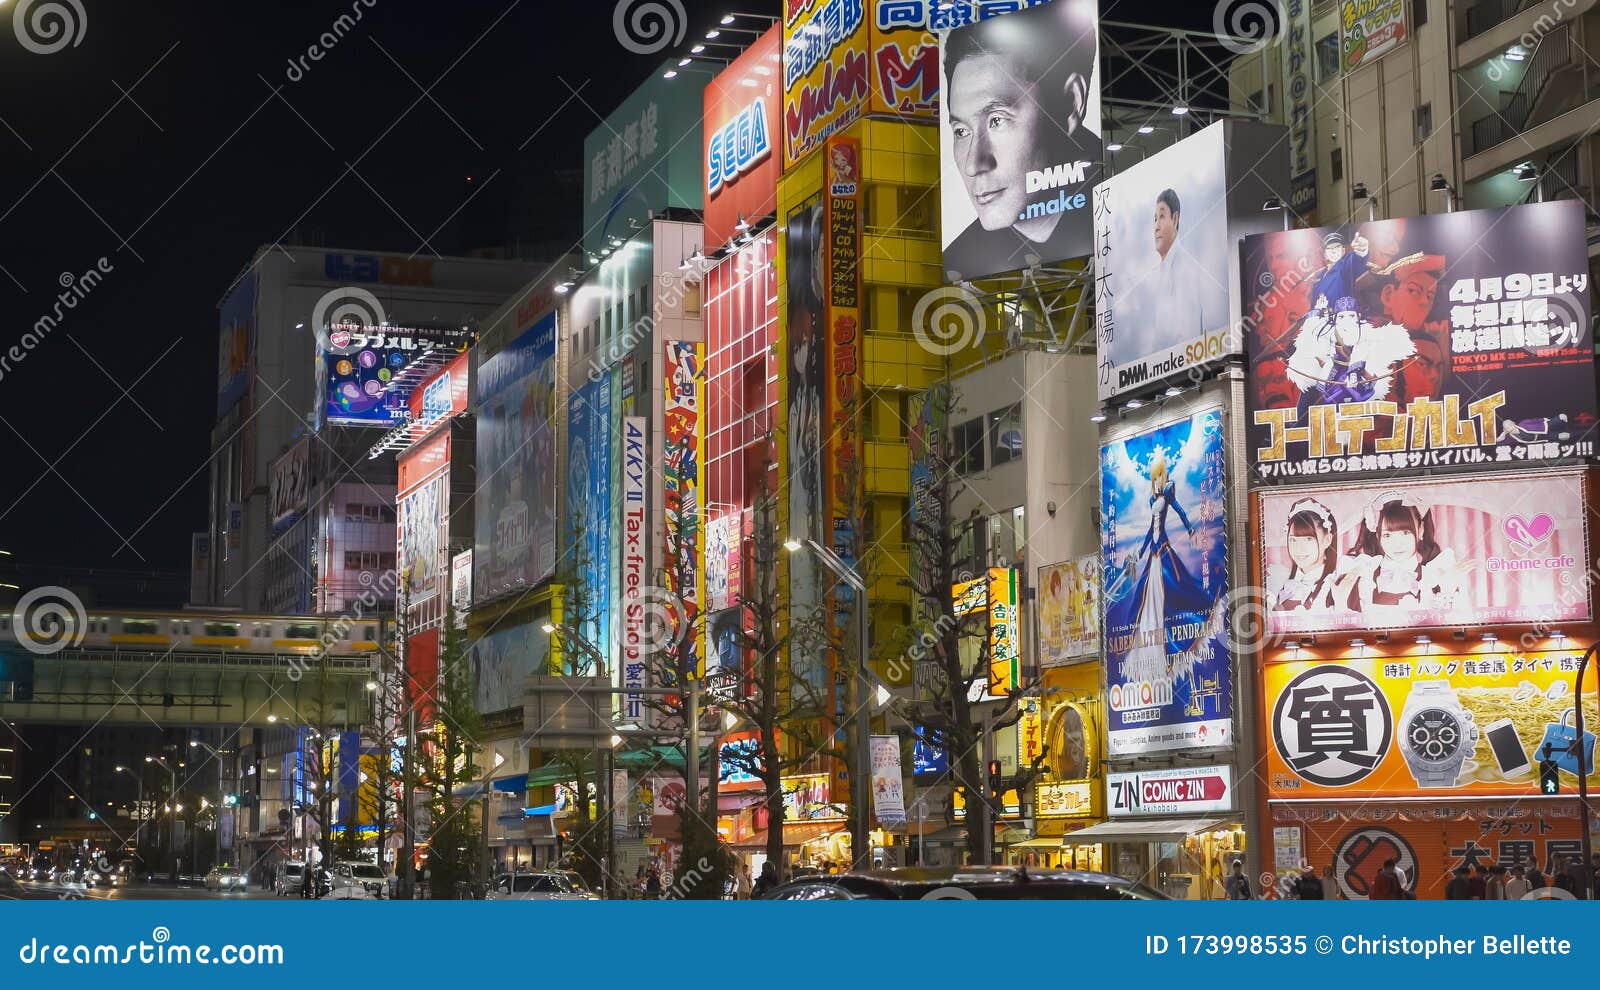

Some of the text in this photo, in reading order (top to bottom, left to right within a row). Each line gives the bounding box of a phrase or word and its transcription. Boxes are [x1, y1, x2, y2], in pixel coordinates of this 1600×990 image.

[708, 97, 769, 195] SEGA
[1026, 160, 1086, 194] DMM
[833, 199, 854, 209] DVD
[1019, 190, 1086, 221] .make
[832, 223, 855, 234] ゲーム
[836, 235, 851, 245] CD
[832, 247, 855, 258] アイドル
[832, 259, 856, 270] アニメ
[833, 272, 855, 281] コミック
[1094, 187, 1116, 396] 次は太陽か。
[1449, 273, 1587, 303] 4月9日より
[1186, 329, 1227, 364] solar
[1452, 353, 1488, 364] TOKYO
[1490, 351, 1506, 361] MX
[1254, 390, 1506, 462] ゴールデンカムイ
[626, 421, 643, 489] AKKY
[626, 507, 644, 600] Tax-free
[1488, 554, 1575, 571] @home cafe
[626, 603, 643, 659] Shop
[993, 602, 1009, 660] 吉野家
[1384, 663, 1411, 678] 時計
[1464, 659, 1507, 675] 貴金属
[1512, 657, 1554, 673] ダイヤ
[1110, 679, 1173, 710] amiami
[1288, 681, 1386, 770] 質
[1111, 774, 1140, 812] ZIN
[1143, 779, 1205, 801] COMIC ZIN
[1273, 779, 1300, 789] 大黒屋
[1480, 819, 1552, 836] チケット
